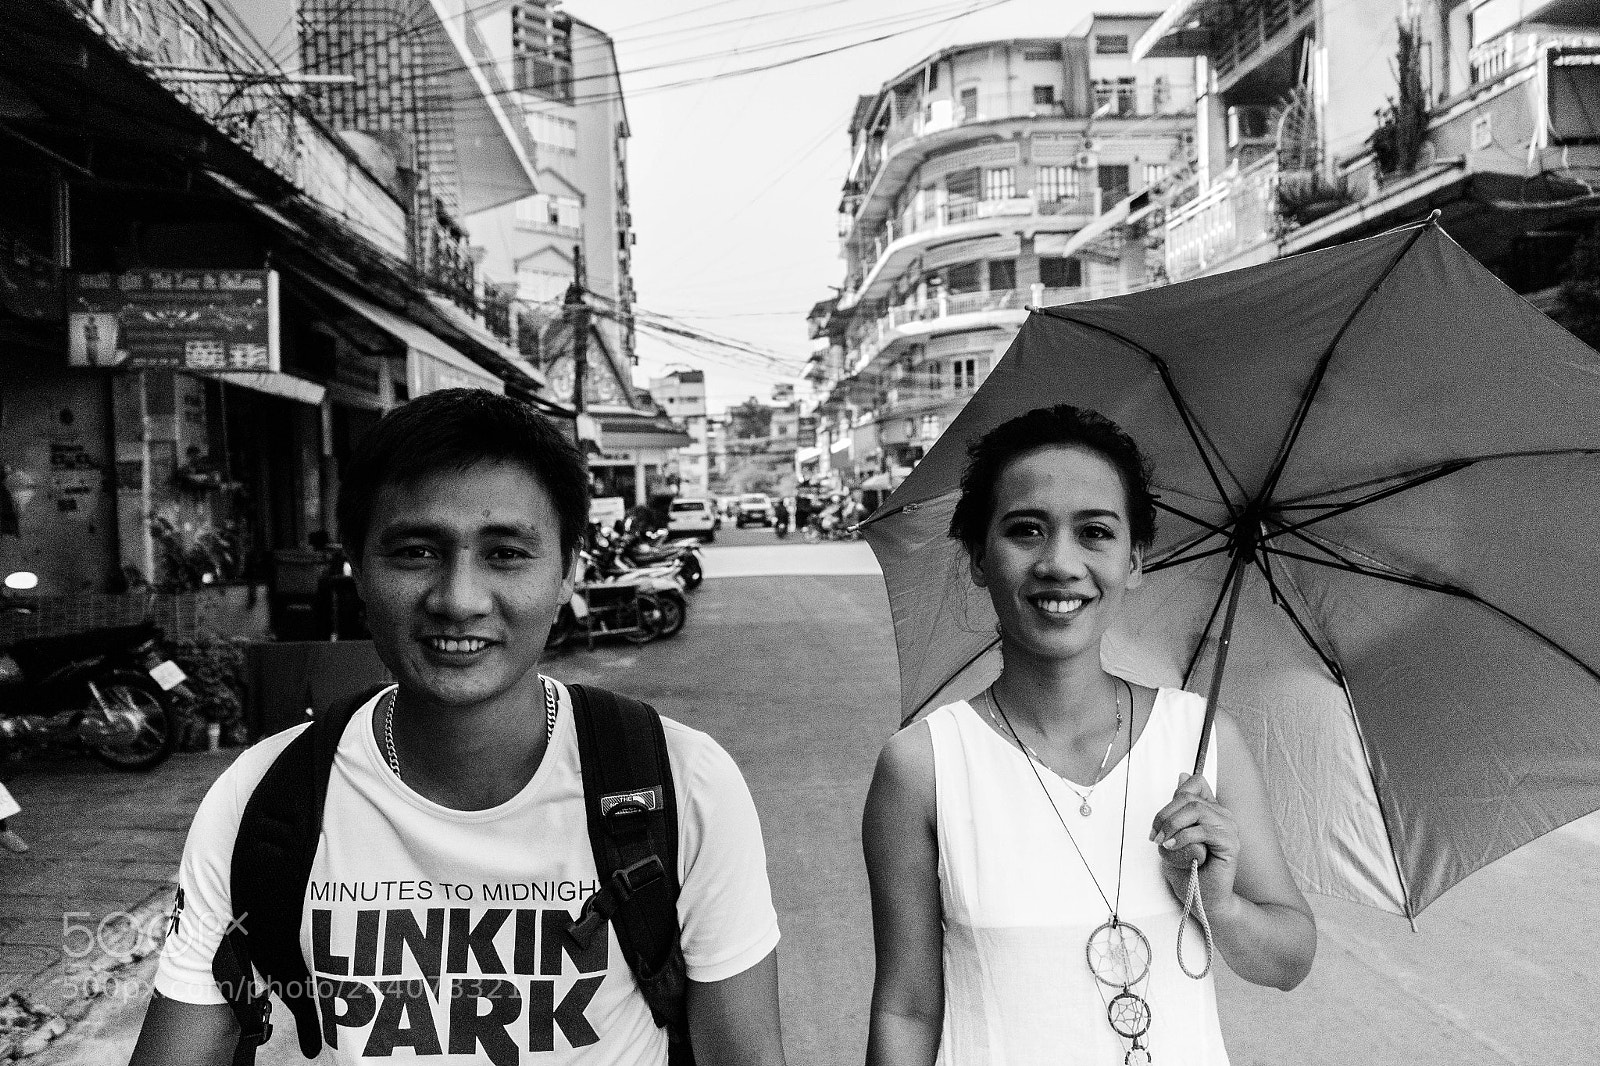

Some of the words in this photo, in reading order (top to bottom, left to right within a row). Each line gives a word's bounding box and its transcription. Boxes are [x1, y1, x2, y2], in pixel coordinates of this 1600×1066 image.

[310, 880, 433, 902] MINUTES
[439, 882, 473, 900] TO
[482, 879, 596, 901] MIDNIGH
[311, 907, 609, 1006] LINKIN
[316, 974, 607, 1066] PARK
